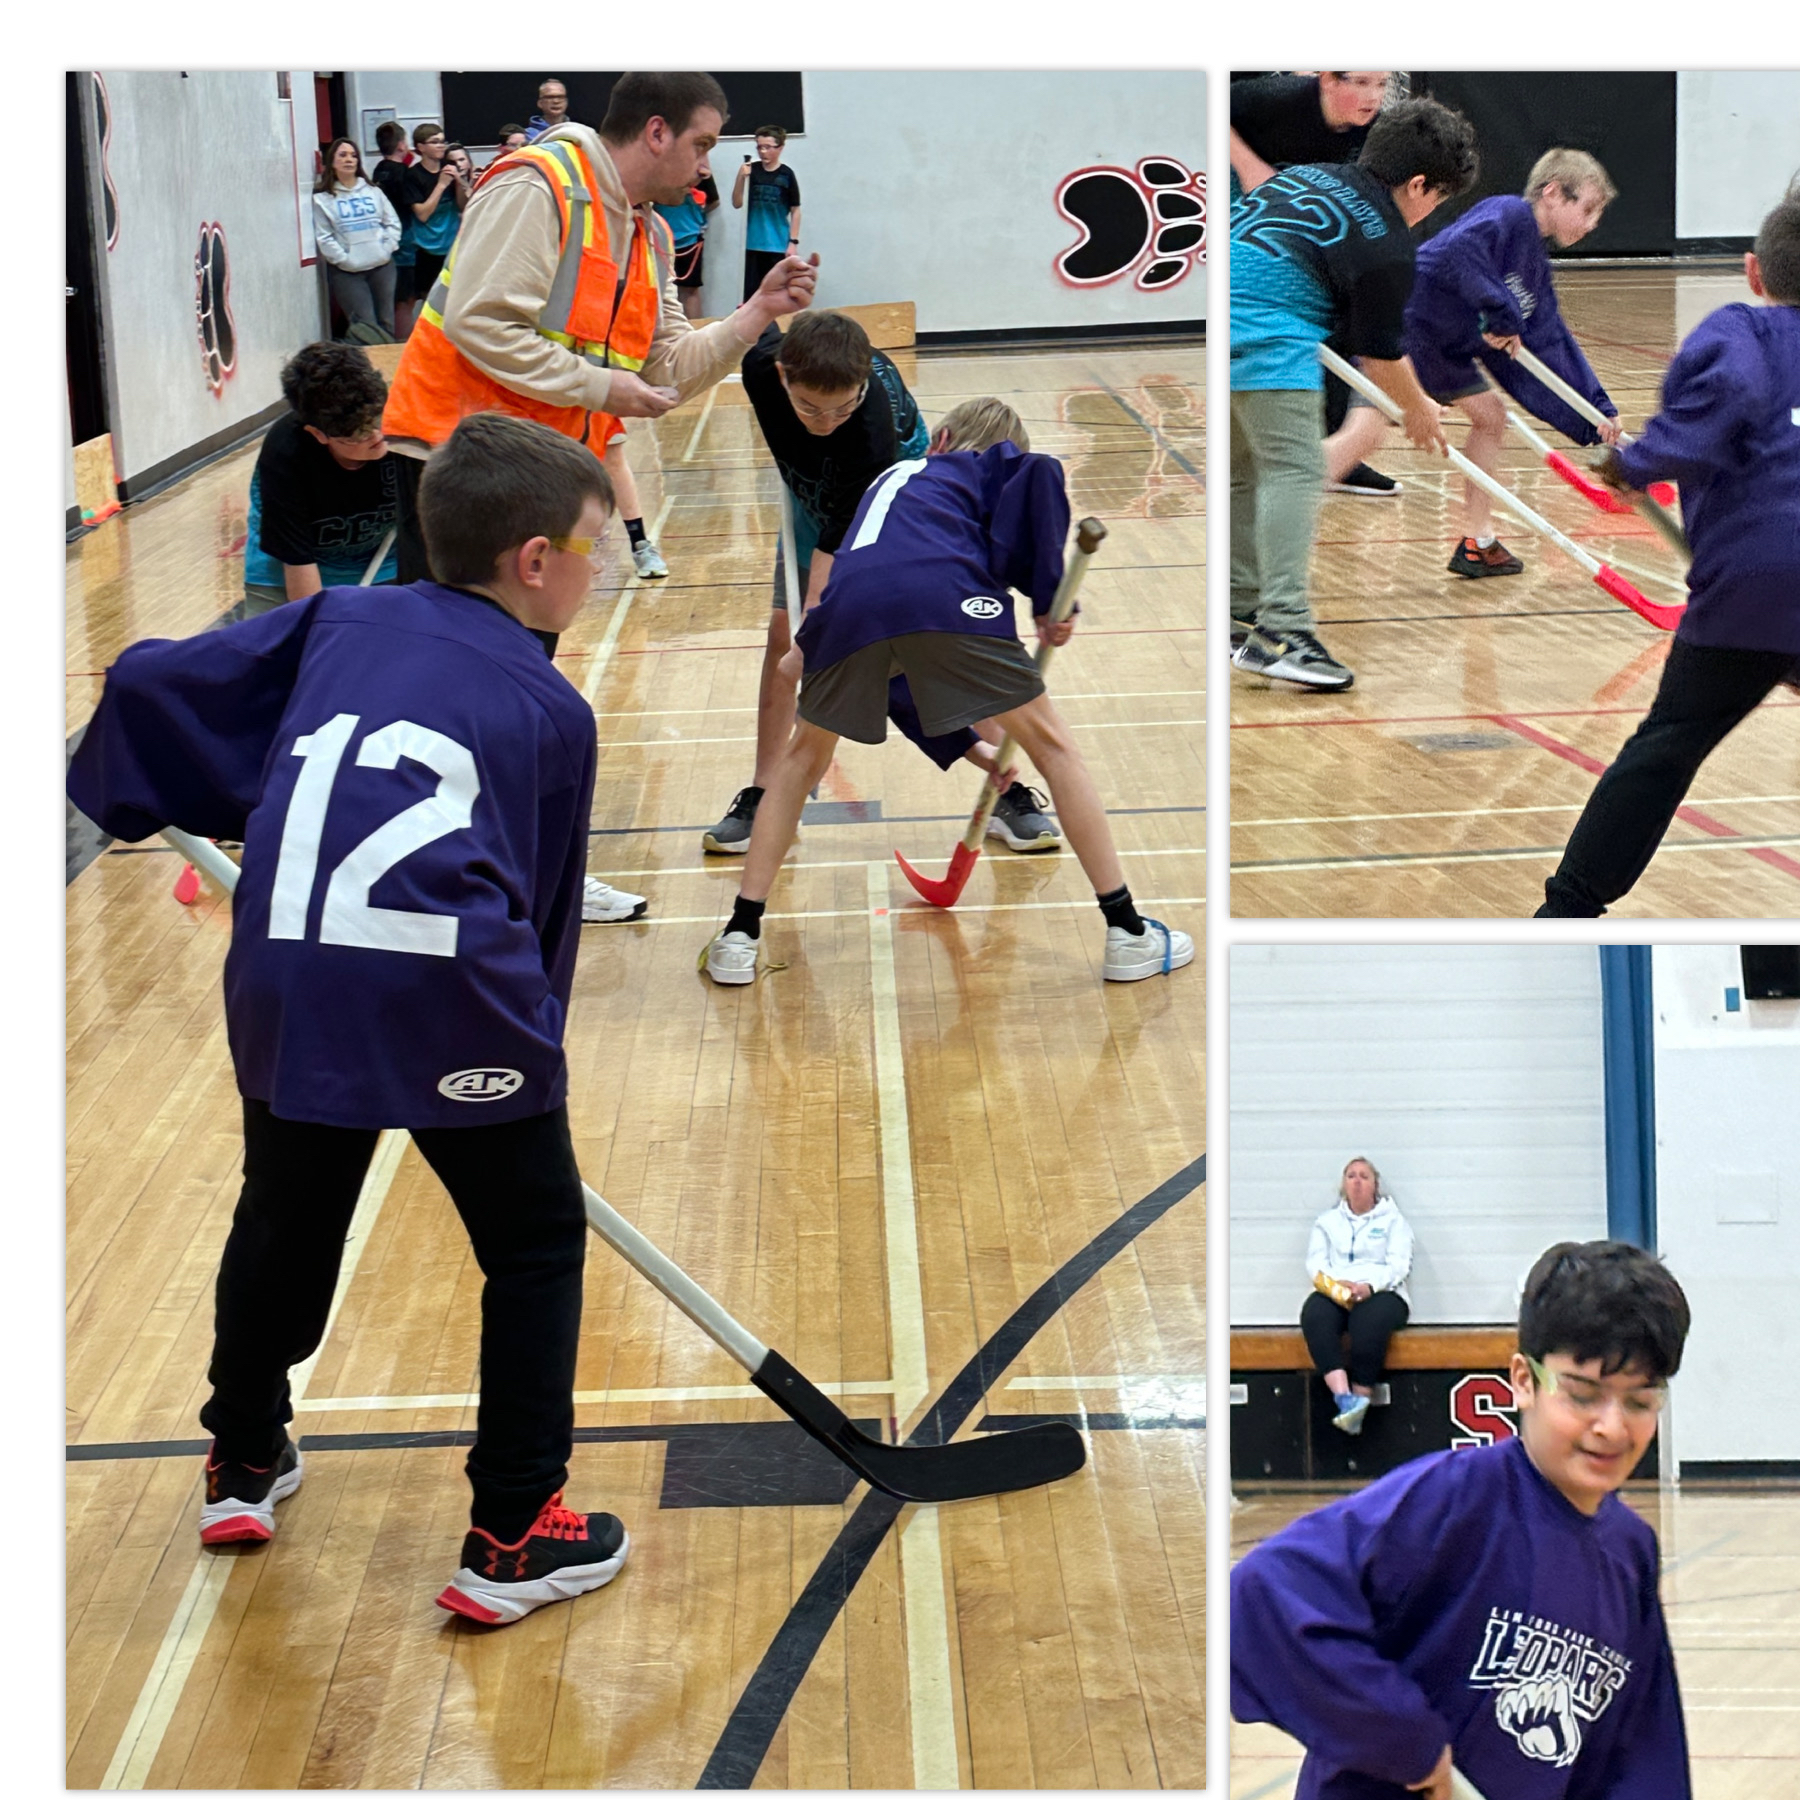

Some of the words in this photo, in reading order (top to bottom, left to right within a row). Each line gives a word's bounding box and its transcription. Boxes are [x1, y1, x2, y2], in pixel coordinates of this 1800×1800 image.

[337, 197, 376, 218] CES
[268, 713, 481, 957] 12
[441, 1070, 521, 1098] AK
[1450, 1374, 1519, 1452] S
